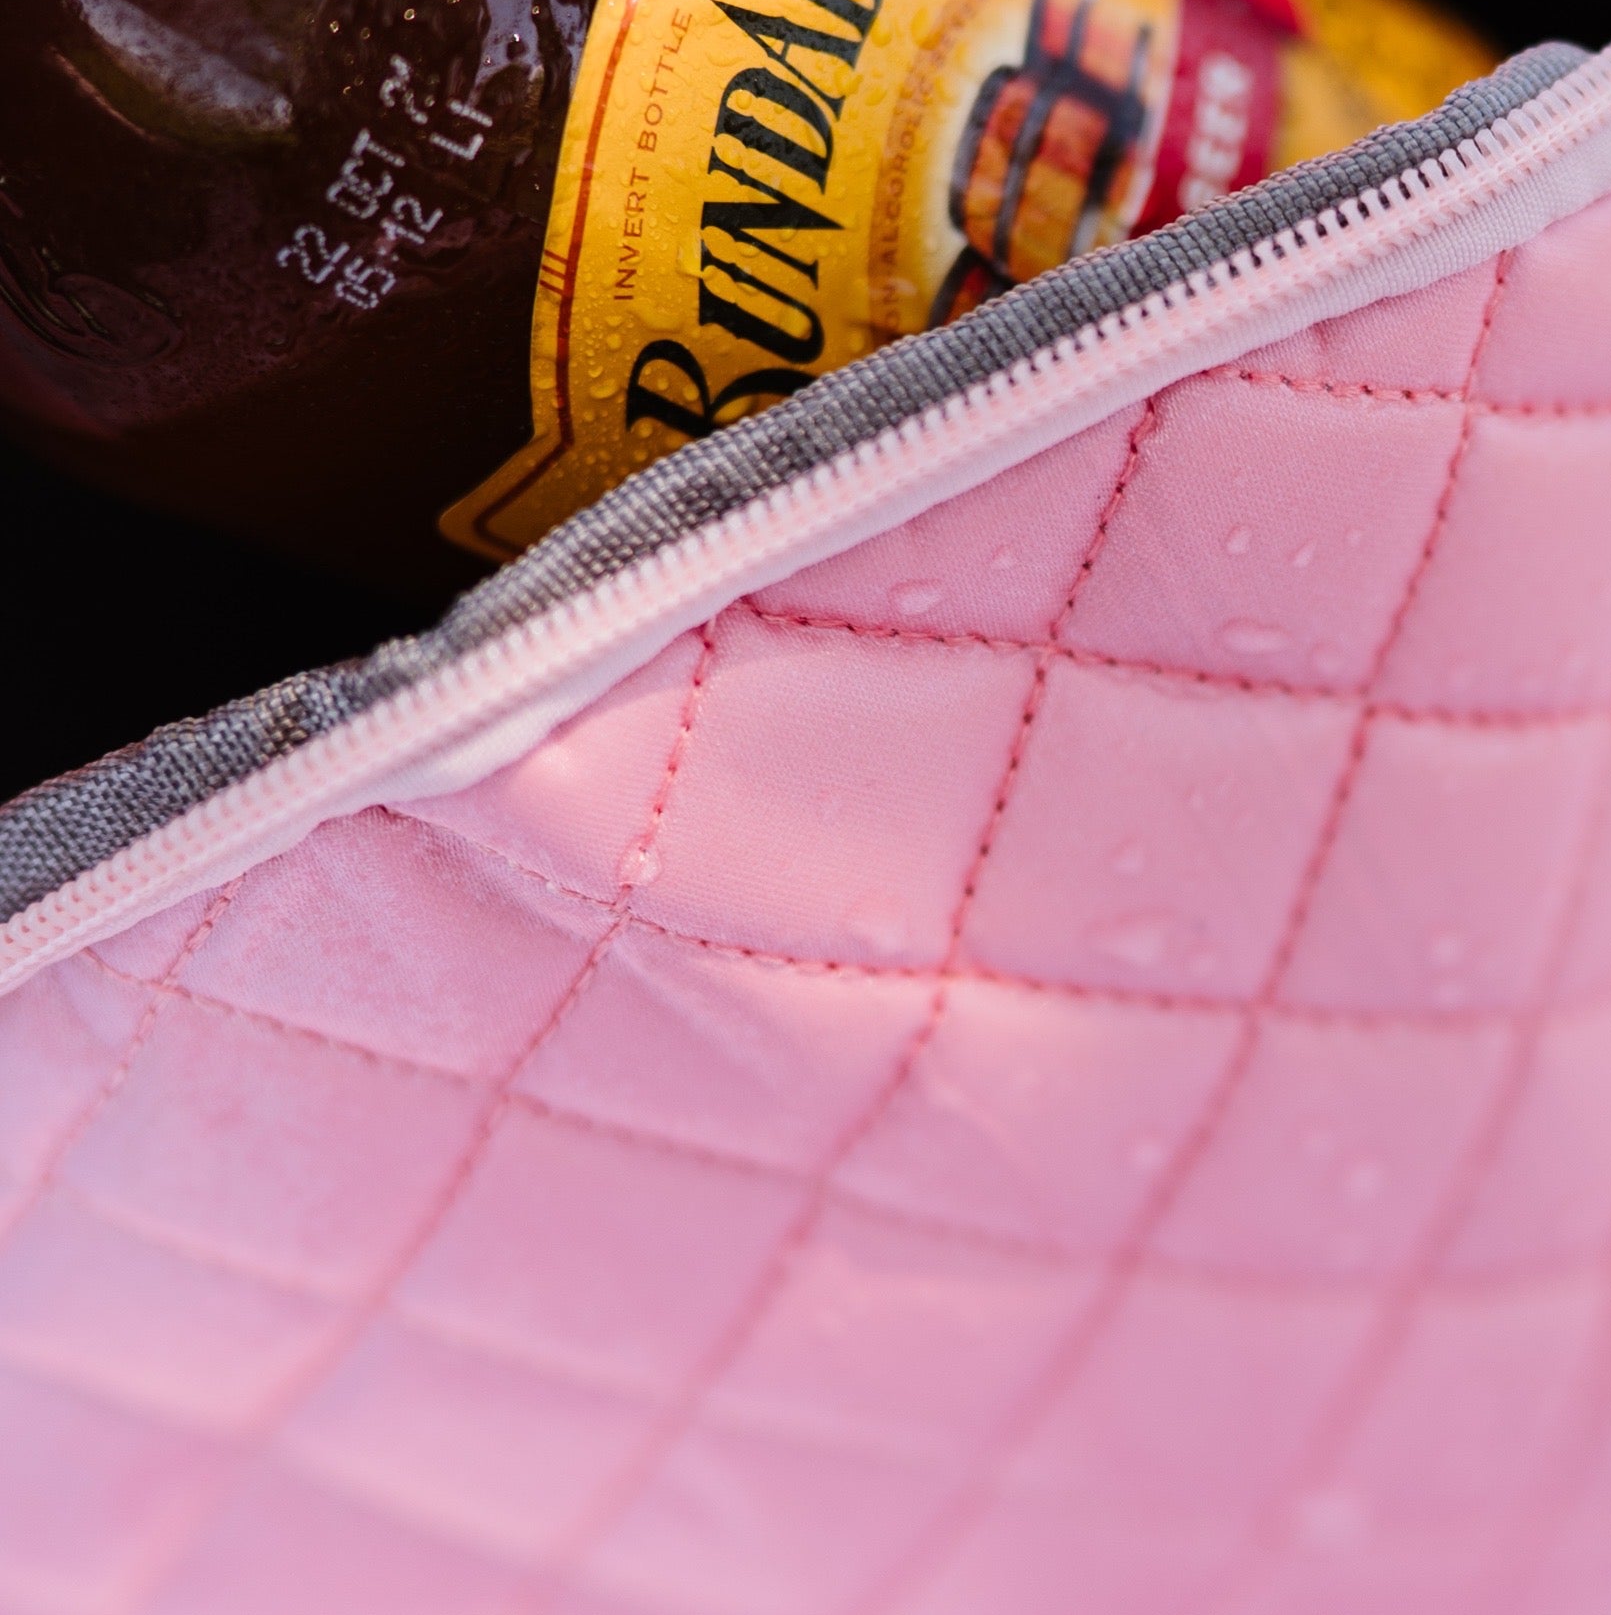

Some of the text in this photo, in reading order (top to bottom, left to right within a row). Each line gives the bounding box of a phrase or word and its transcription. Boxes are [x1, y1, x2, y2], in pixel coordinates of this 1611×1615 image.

[276, 225, 349, 283] 22
[326, 129, 405, 220] OCT
[613, 167, 650, 301] INVERT
[637, 8, 693, 153] BOTTLE
[335, 195, 443, 308] 05:12
